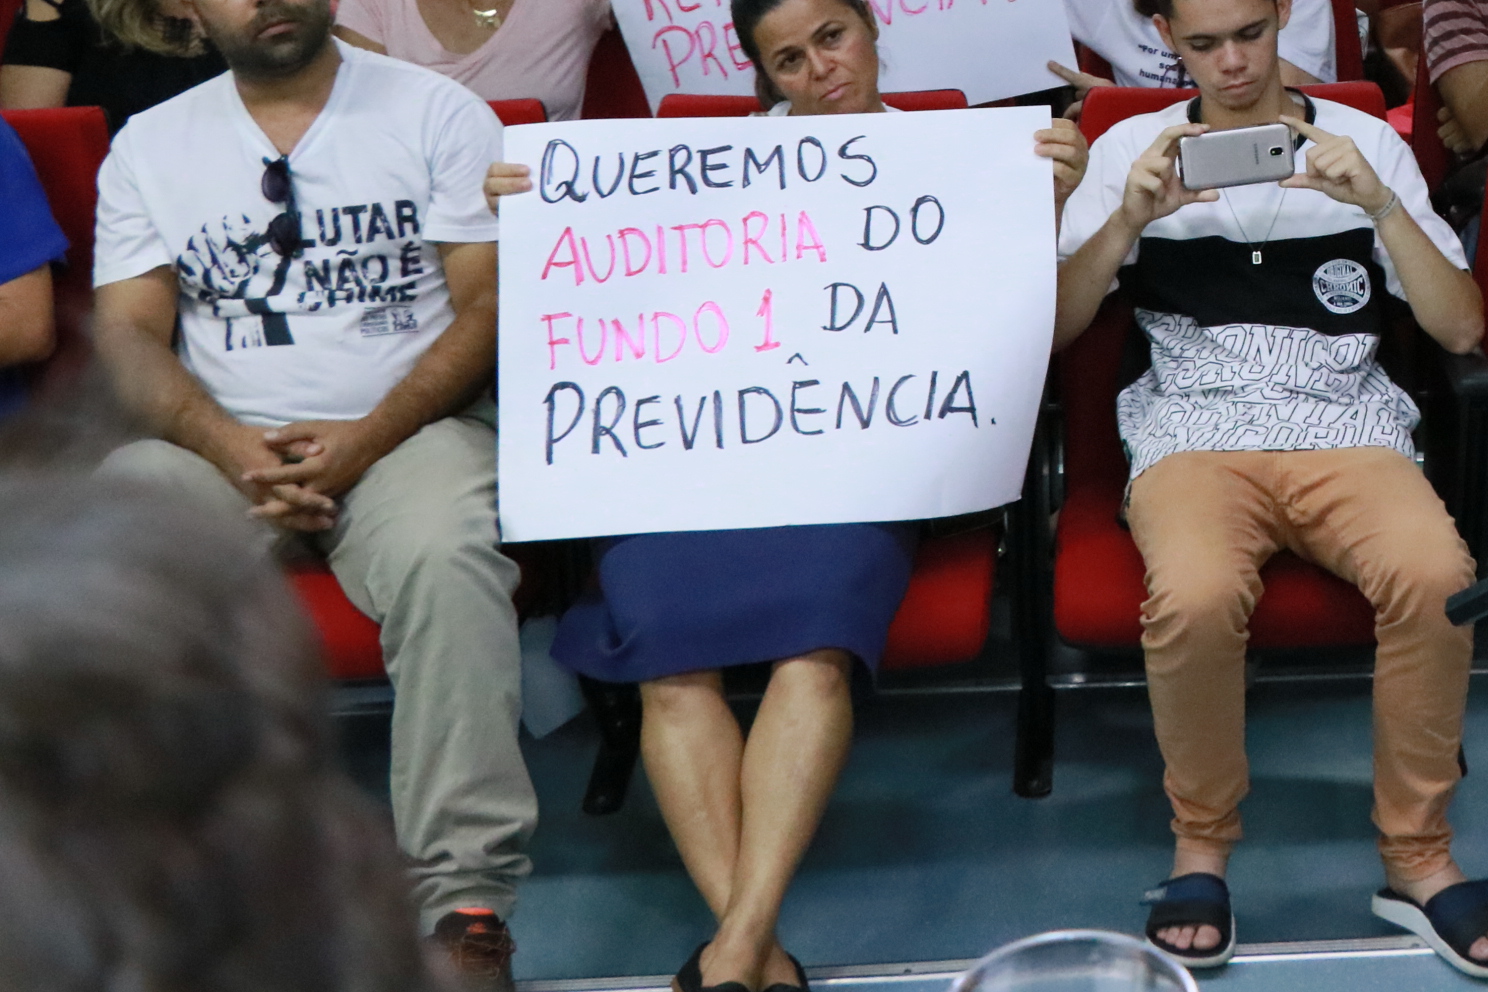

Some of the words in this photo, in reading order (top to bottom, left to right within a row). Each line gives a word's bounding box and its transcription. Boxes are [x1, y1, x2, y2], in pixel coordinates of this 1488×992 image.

[539, 135, 879, 204] QUEREMOS
[304, 249, 390, 292] NÃO
[540, 210, 828, 286] AUDITORIA
[857, 194, 946, 252] DO
[540, 300, 730, 370] FUNDO
[753, 288, 782, 352] 1
[820, 281, 899, 335] DA
[1319, 277, 1364, 295] CHRONIC
[542, 352, 998, 466] PREVIDÊNCIA.
